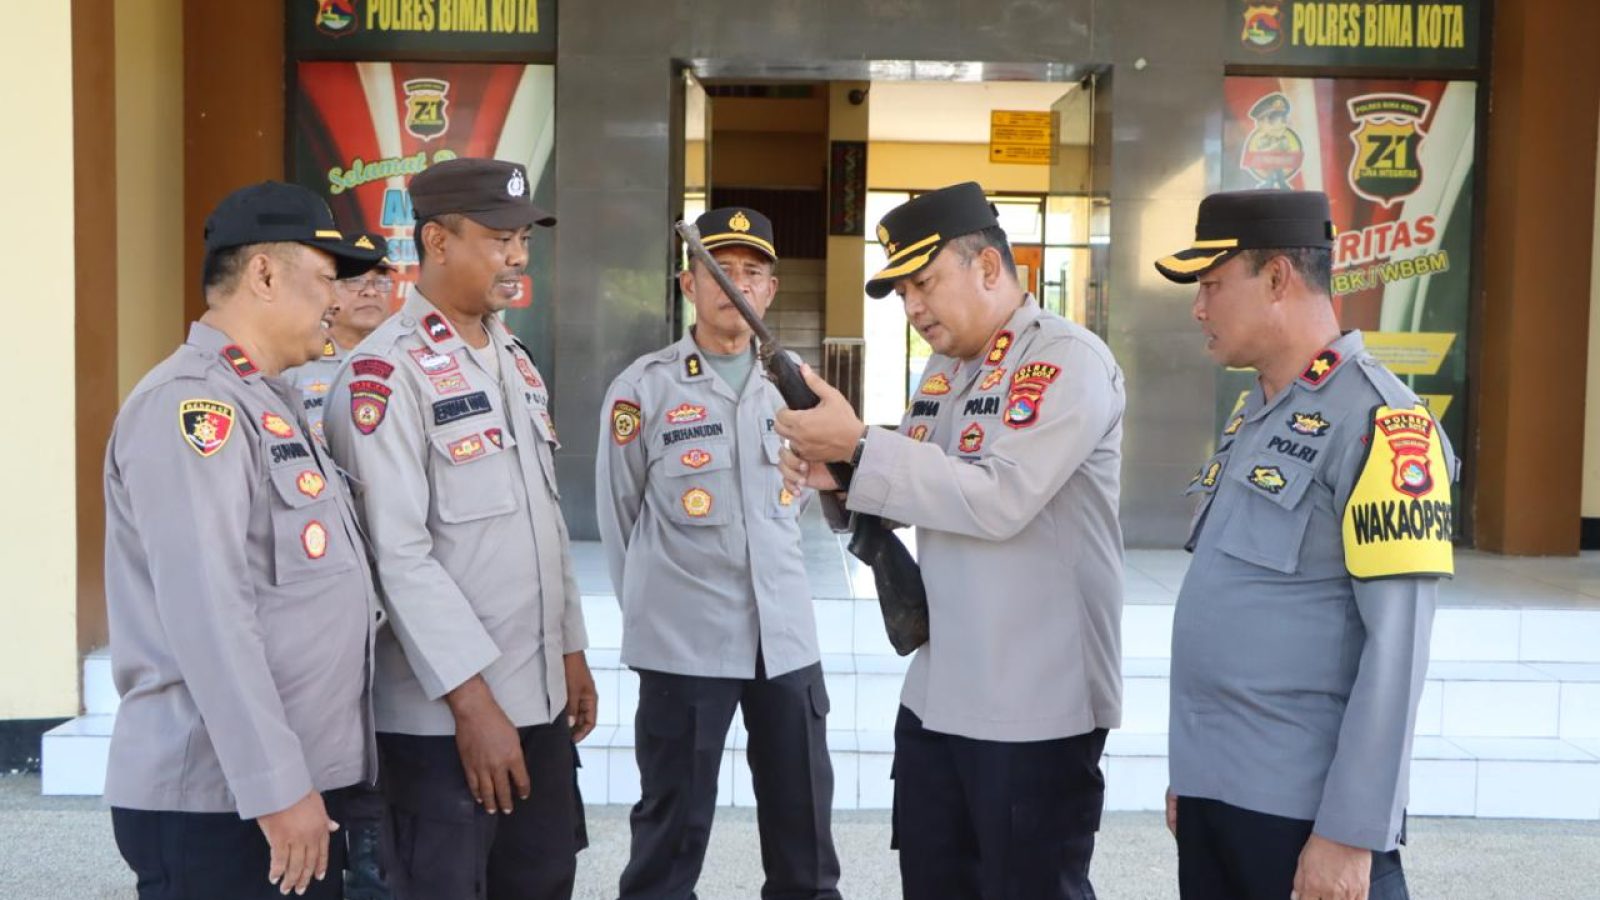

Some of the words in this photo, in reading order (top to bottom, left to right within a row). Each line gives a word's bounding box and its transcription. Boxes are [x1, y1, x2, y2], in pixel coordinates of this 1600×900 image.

[366, 0, 435, 32] POLRES
[439, 0, 488, 33] BIMA
[491, 0, 539, 34] KOTA
[1292, 2, 1361, 46] POLRES
[1364, 4, 1413, 48] BIMA
[1416, 5, 1465, 48] KOTA
[1337, 214, 1437, 263] RITAS
[1332, 269, 1364, 293] BK
[1379, 252, 1448, 284] WBBM
[963, 396, 1000, 416] POLRI
[662, 423, 723, 445] BURHANUDIN
[1267, 435, 1319, 463] POLRI
